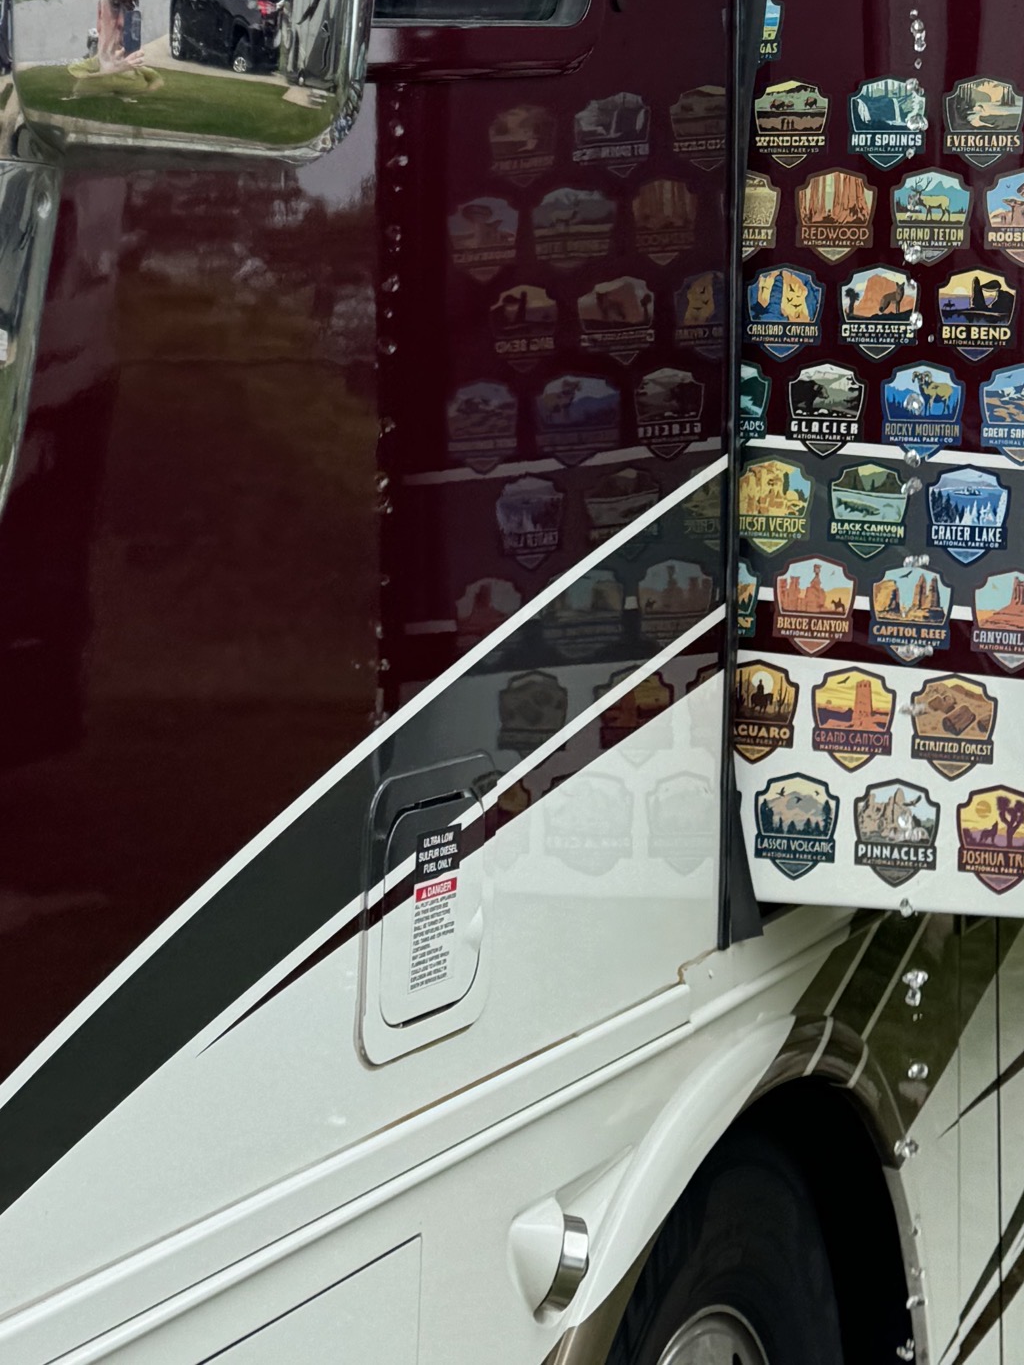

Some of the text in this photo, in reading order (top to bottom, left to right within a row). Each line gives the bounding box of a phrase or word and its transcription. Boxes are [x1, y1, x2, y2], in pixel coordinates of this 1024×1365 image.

[759, 43, 778, 54] GAS
[851, 134, 922, 146] HOT SPRINGS
[946, 135, 1020, 147] EVERGLADES
[742, 228, 773, 240] ALLEY
[801, 227, 869, 240] REDWOOD
[896, 228, 964, 240] GRAND TETON
[747, 324, 818, 336] CARLSBAD CAVERNS
[841, 324, 914, 338] GUADALUPE
[942, 326, 1011, 340] BIG BEND
[790, 421, 858, 434] GLACIER
[885, 423, 959, 437] ROCKY MOUNTAIN
[983, 427, 1008, 439] GREAT
[769, 517, 806, 533] VERDE
[831, 522, 904, 538] BLACK CANYON
[931, 525, 1002, 542] CRATER LAKE
[777, 617, 849, 633] BRYCE CANYON
[873, 625, 947, 640] CAPITOL REEF
[979, 644, 1011, 652] NATIONAL
[733, 724, 790, 739] GUARO
[814, 731, 890, 747] GRAND CANYON
[914, 738, 992, 755] PETRIFIED FOREST
[423, 831, 454, 848] ULTRA LOW
[757, 838, 833, 854] LASSEN VOLCANIC
[418, 843, 458, 863] SULFUR DIESEL
[762, 851, 794, 859] NATIONAL
[858, 844, 934, 862] PINNACLES
[962, 850, 1005, 866] JOSHUA
[423, 857, 453, 874] FUEL ONLY
[965, 865, 998, 873] NATIONAL
[427, 881, 452, 897] DANGER
